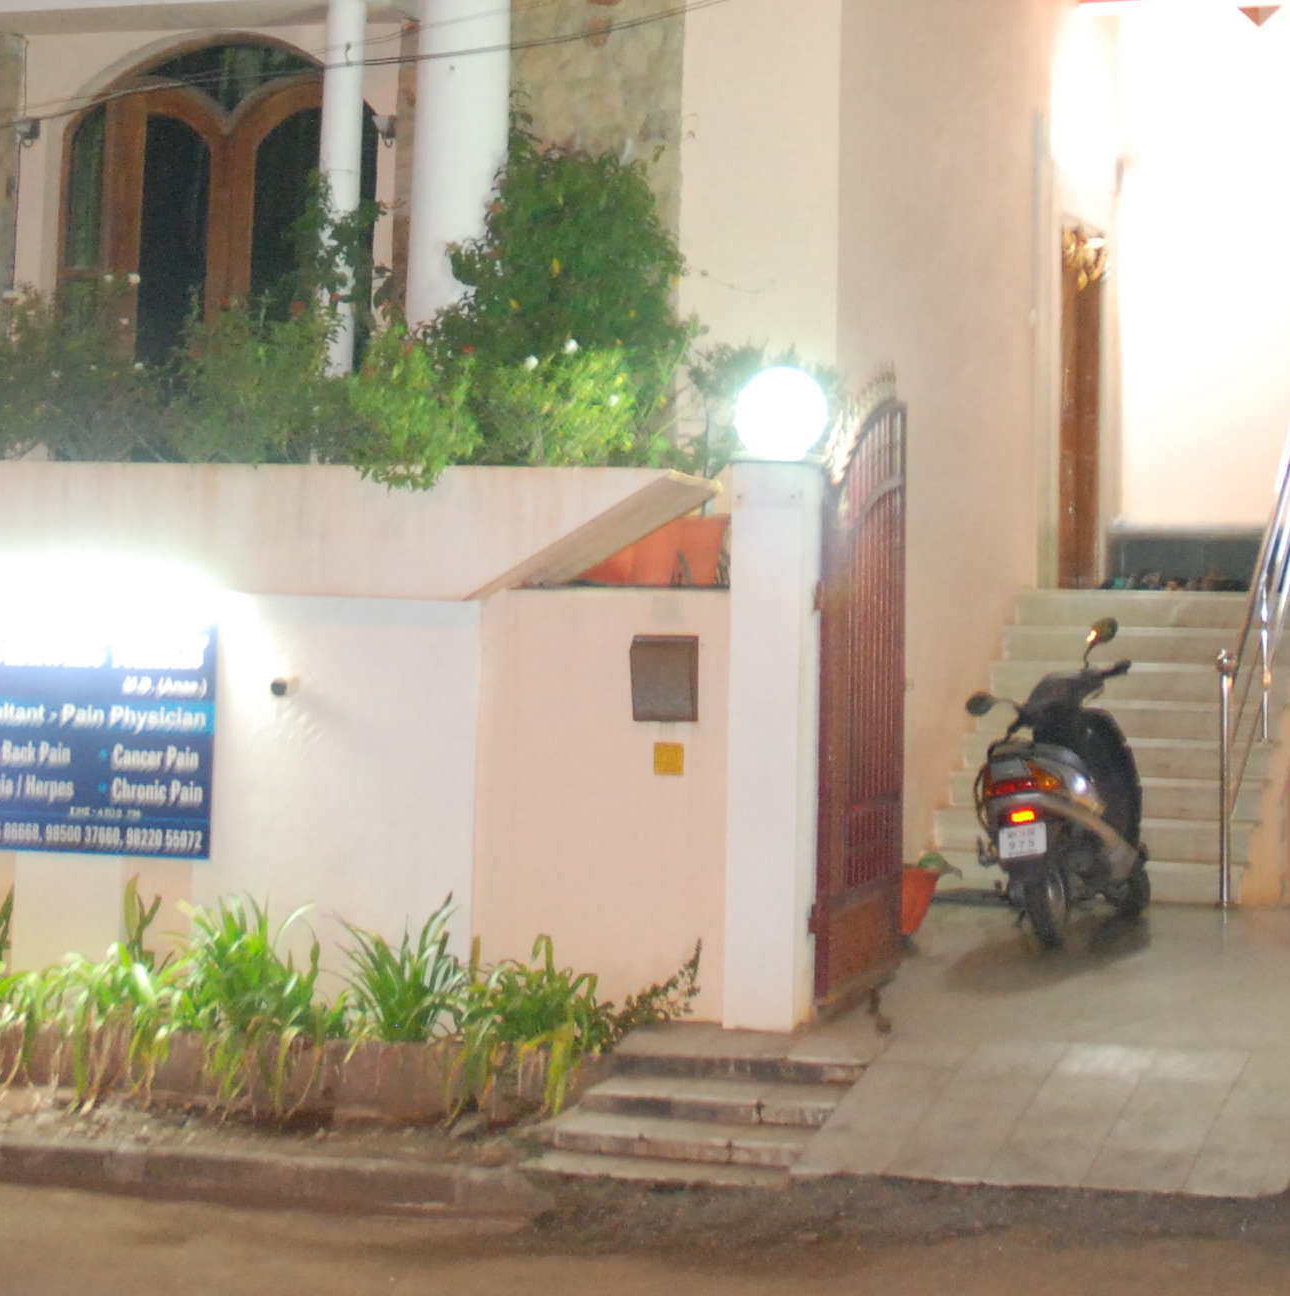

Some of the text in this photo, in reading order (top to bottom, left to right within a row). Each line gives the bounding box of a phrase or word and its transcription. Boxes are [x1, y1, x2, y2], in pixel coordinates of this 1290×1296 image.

[59, 702, 105, 728] Pain
[109, 705, 206, 733] Physician
[1, 740, 36, 765] Back
[39, 741, 71, 766] Pain
[112, 744, 199, 770] Cancer Pain
[25, 775, 74, 801] Herpes
[111, 777, 203, 805] Chronic Pain
